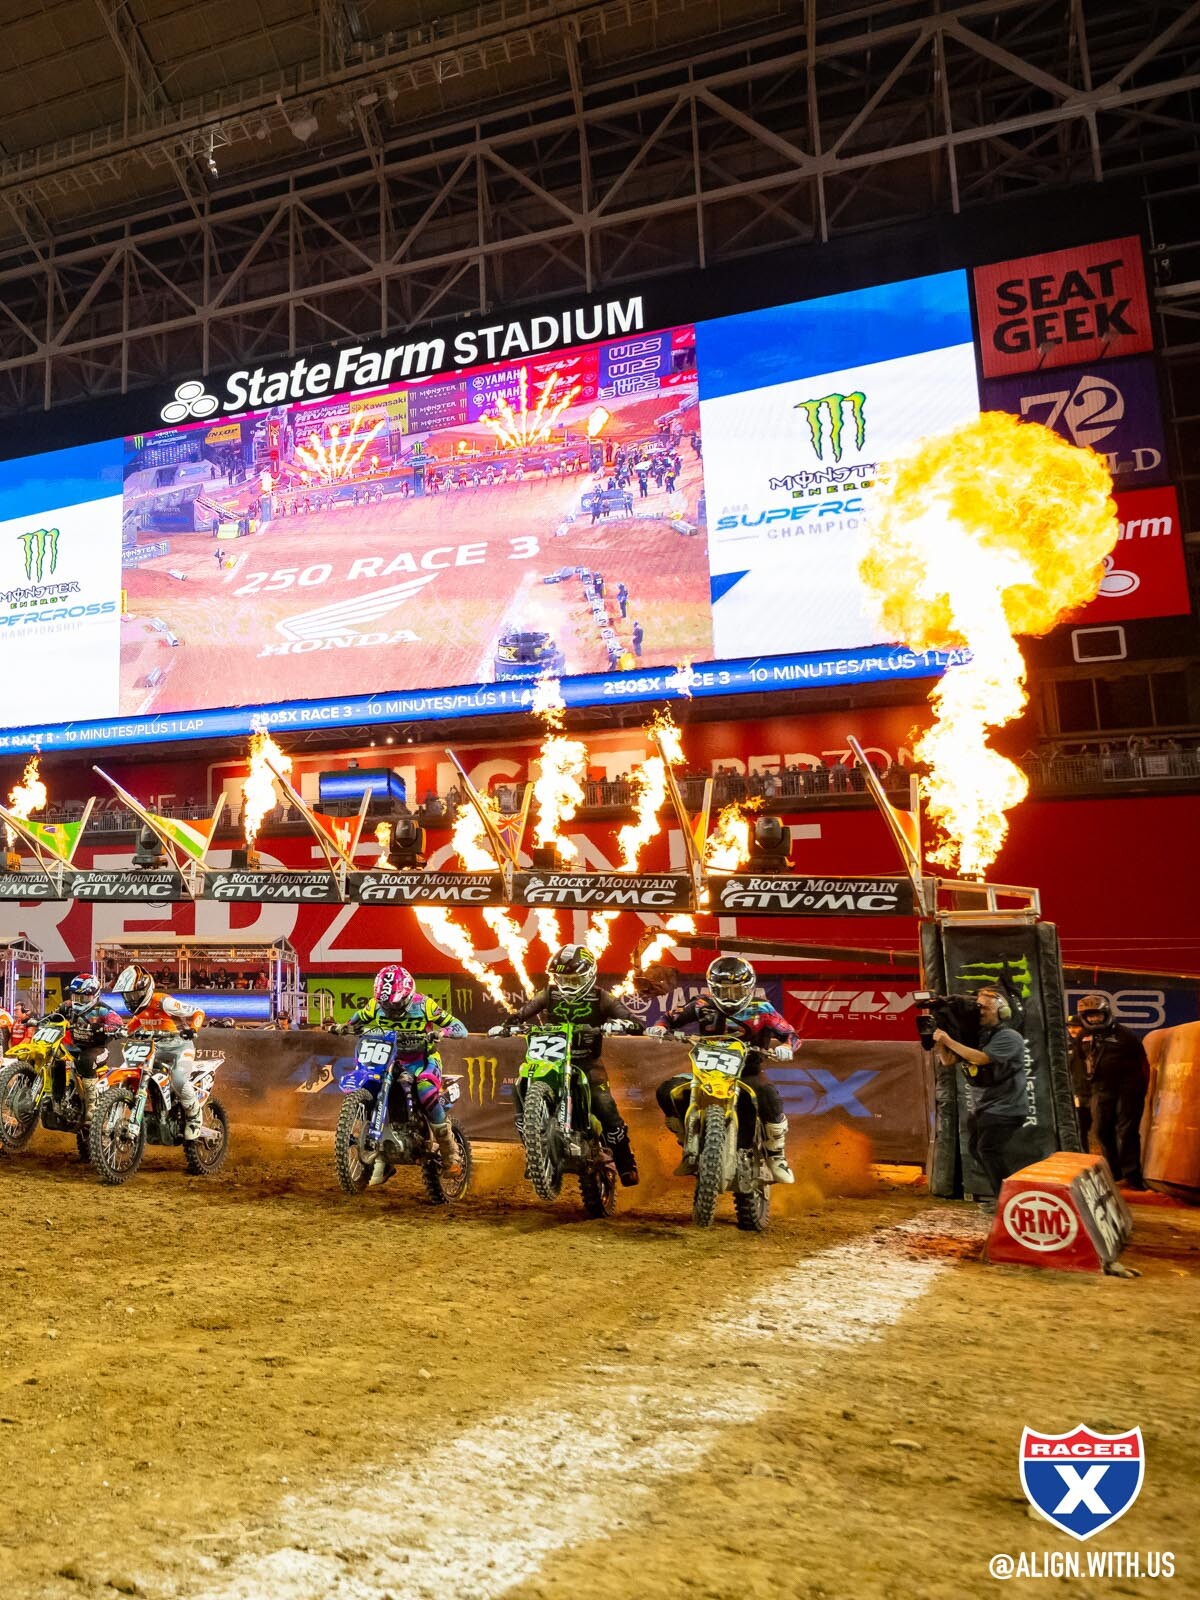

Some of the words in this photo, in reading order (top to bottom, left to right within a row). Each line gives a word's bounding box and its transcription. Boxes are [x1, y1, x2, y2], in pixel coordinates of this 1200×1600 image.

[995, 259, 1124, 316] SEAT
[453, 296, 645, 366] STADIUM
[993, 299, 1139, 355] GEEK
[484, 369, 521, 385] YAMAH
[715, 498, 865, 531] SUPERC
[767, 518, 860, 540] CHAMPIO
[233, 564, 333, 596] 250
[346, 542, 489, 580] RACE
[508, 535, 540, 560] 3
[10, 595, 69, 610] ENERGY
[256, 629, 423, 658] HONDA
[719, 672, 730, 685] 3
[749, 668, 768, 682] 10
[301, 707, 340, 721] RACE
[343, 706, 352, 718] 3
[368, 703, 382, 716] 10
[385, 693, 497, 715] MINUTES/PLUS
[65, 730, 77, 742] 10
[79, 723, 169, 740] MINUTES/PLUS
[179, 719, 204, 732] LAP
[3, 874, 49, 883] MOUNTAIN
[88, 873, 119, 882] ROCKY
[119, 873, 174, 883] MOUNTAIN
[230, 873, 267, 884] ROCKY
[269, 873, 330, 884] MOUNTAIN
[379, 874, 421, 885] ROCKY
[422, 875, 492, 886] MOUNTAIN
[548, 876, 594, 888] ROCKY
[596, 877, 677, 889] MOUNTAIN
[748, 878, 804, 891] ROCKY
[805, 879, 899, 893] MOUNTAIN
[381, 972, 394, 996] FXR
[817, 1013, 900, 1021] RACING
[124, 1045, 151, 1062] 42
[195, 1050, 226, 1059] STER
[359, 1041, 391, 1064] 56
[528, 1036, 567, 1061] 52
[696, 1050, 741, 1075] 53
[1019, 1207, 1062, 1235] RM
